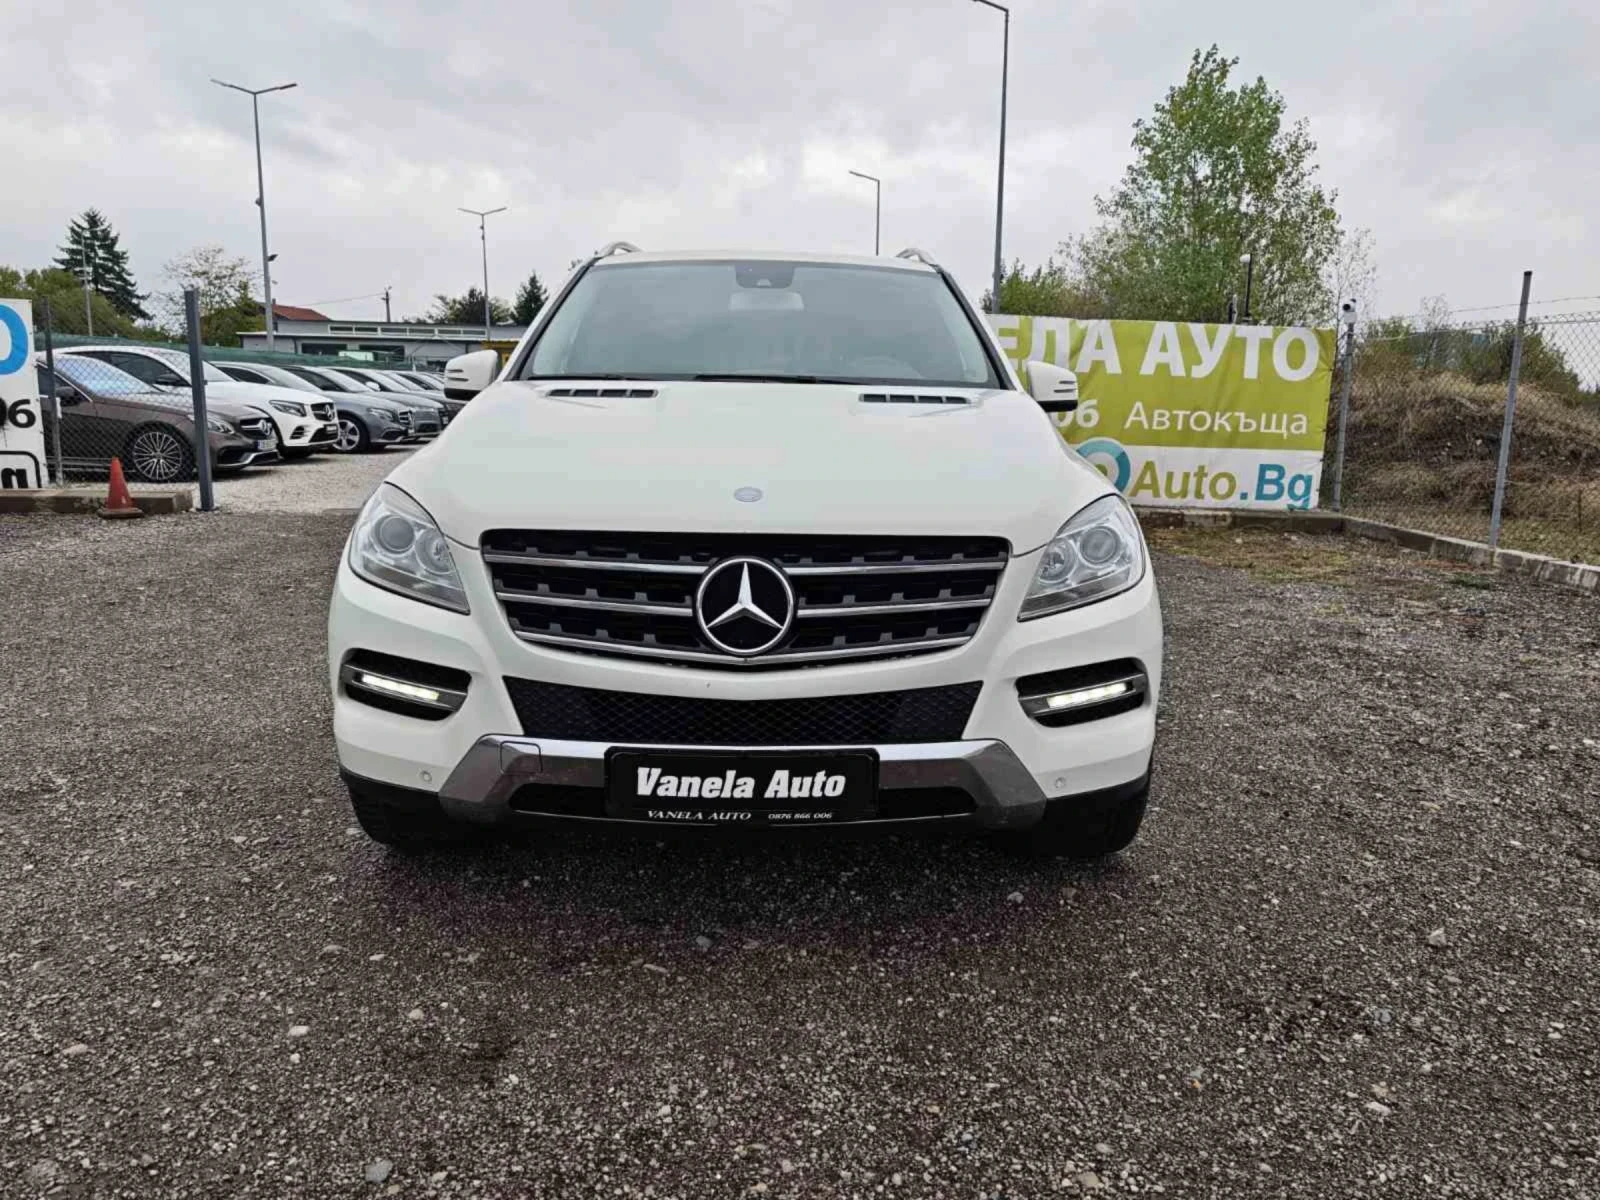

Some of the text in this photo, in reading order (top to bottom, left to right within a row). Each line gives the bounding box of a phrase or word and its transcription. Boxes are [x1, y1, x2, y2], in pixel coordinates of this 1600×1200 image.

[1139, 320, 1320, 381] АУТО
[1124, 401, 1309, 439] Автокъща
[636, 766, 846, 799] Vanela Auto
[647, 810, 752, 821] VANELA AUTO
